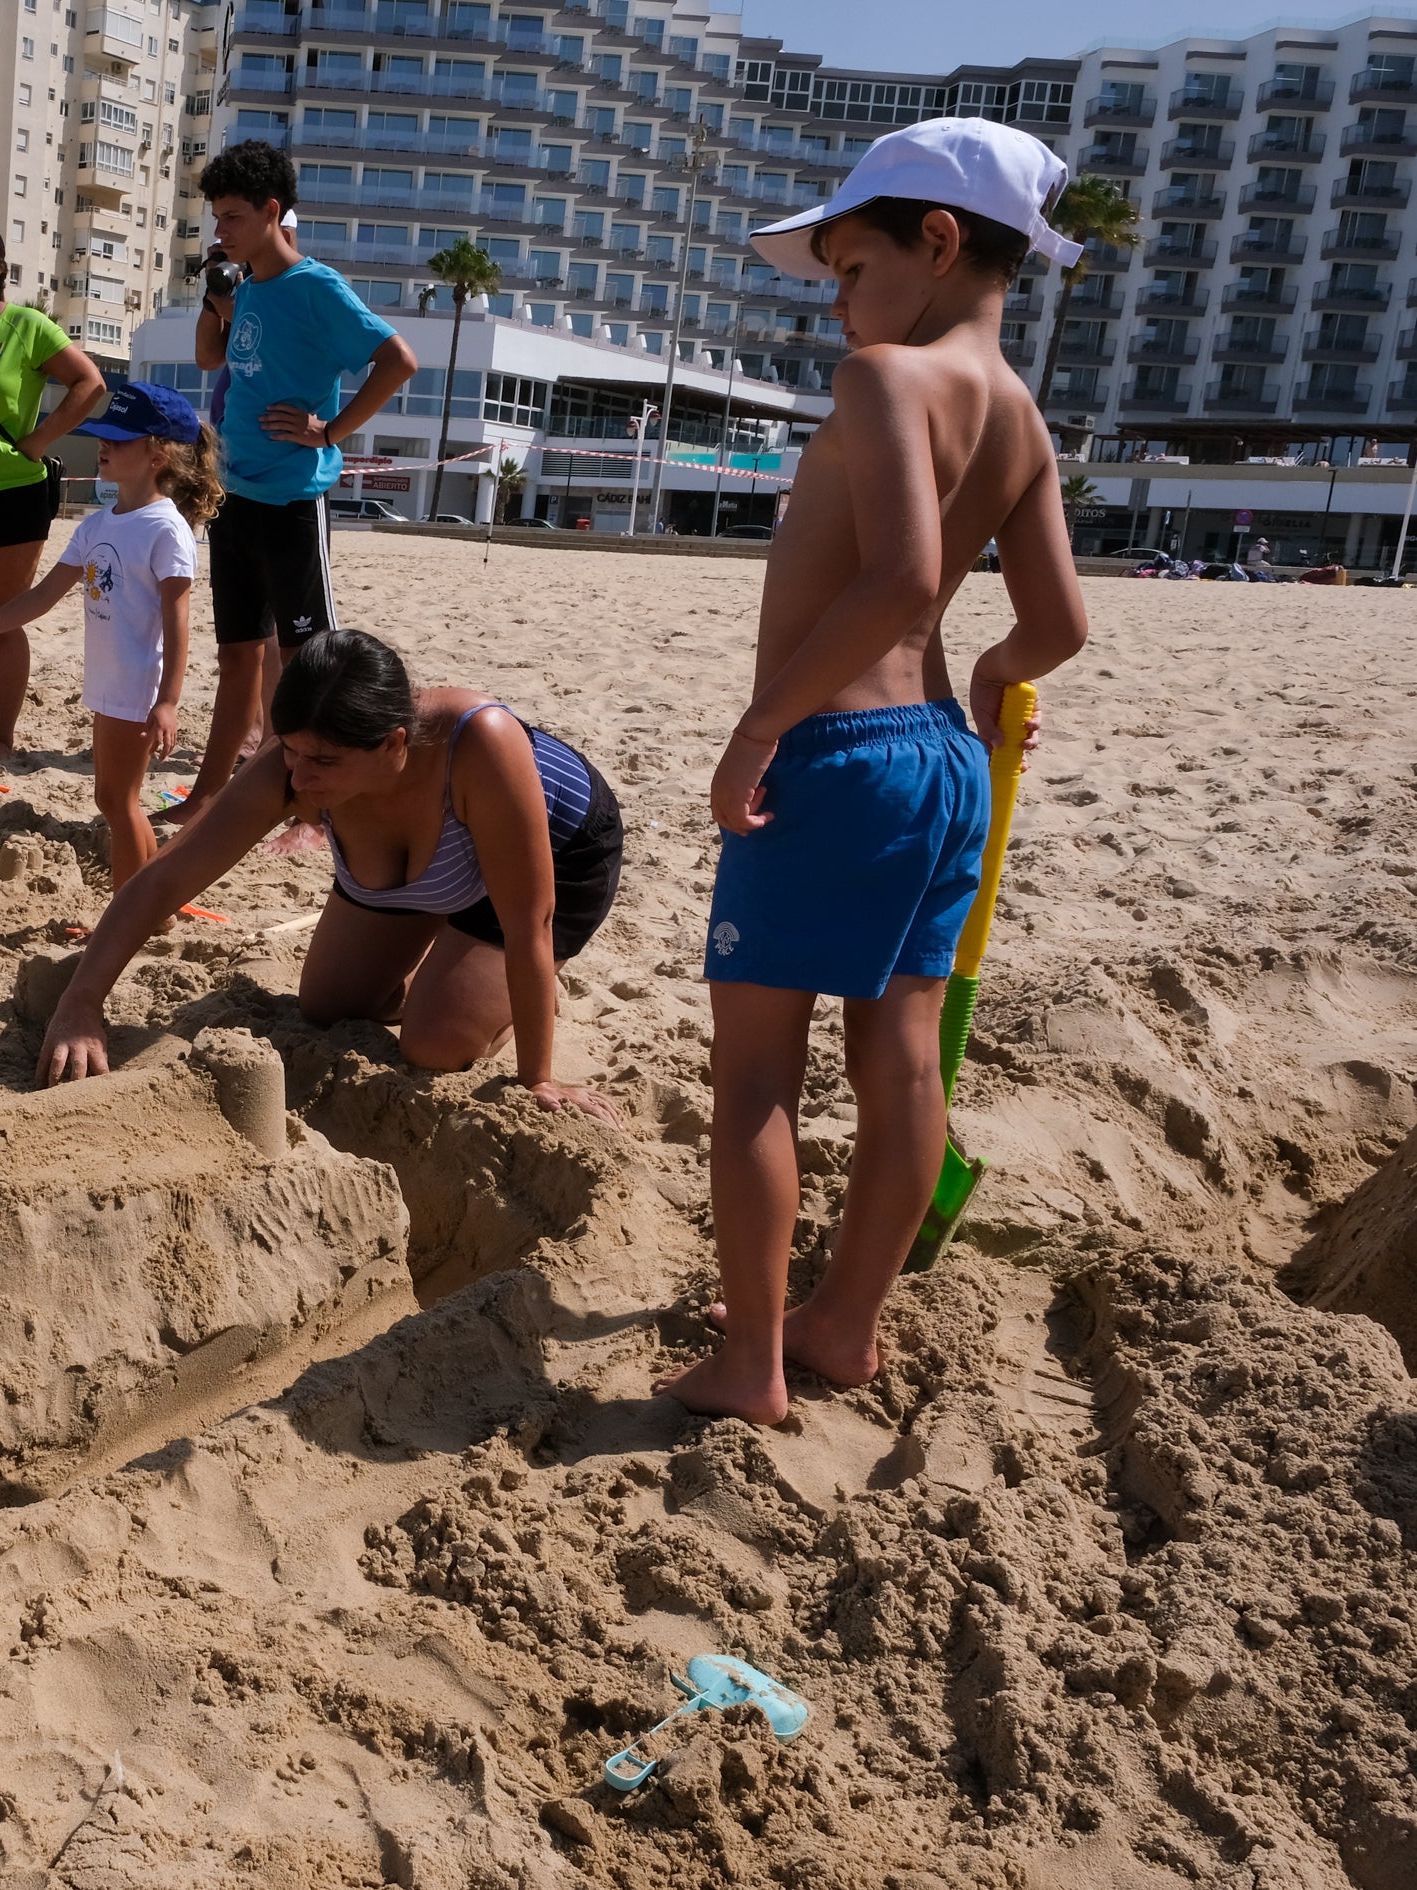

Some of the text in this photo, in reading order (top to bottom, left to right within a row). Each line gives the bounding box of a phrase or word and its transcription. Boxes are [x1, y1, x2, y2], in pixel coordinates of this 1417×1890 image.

[343, 456, 393, 465] superdiplo
[372, 482, 408, 491] ABIERTO
[597, 492, 627, 503] CÁDIZ
